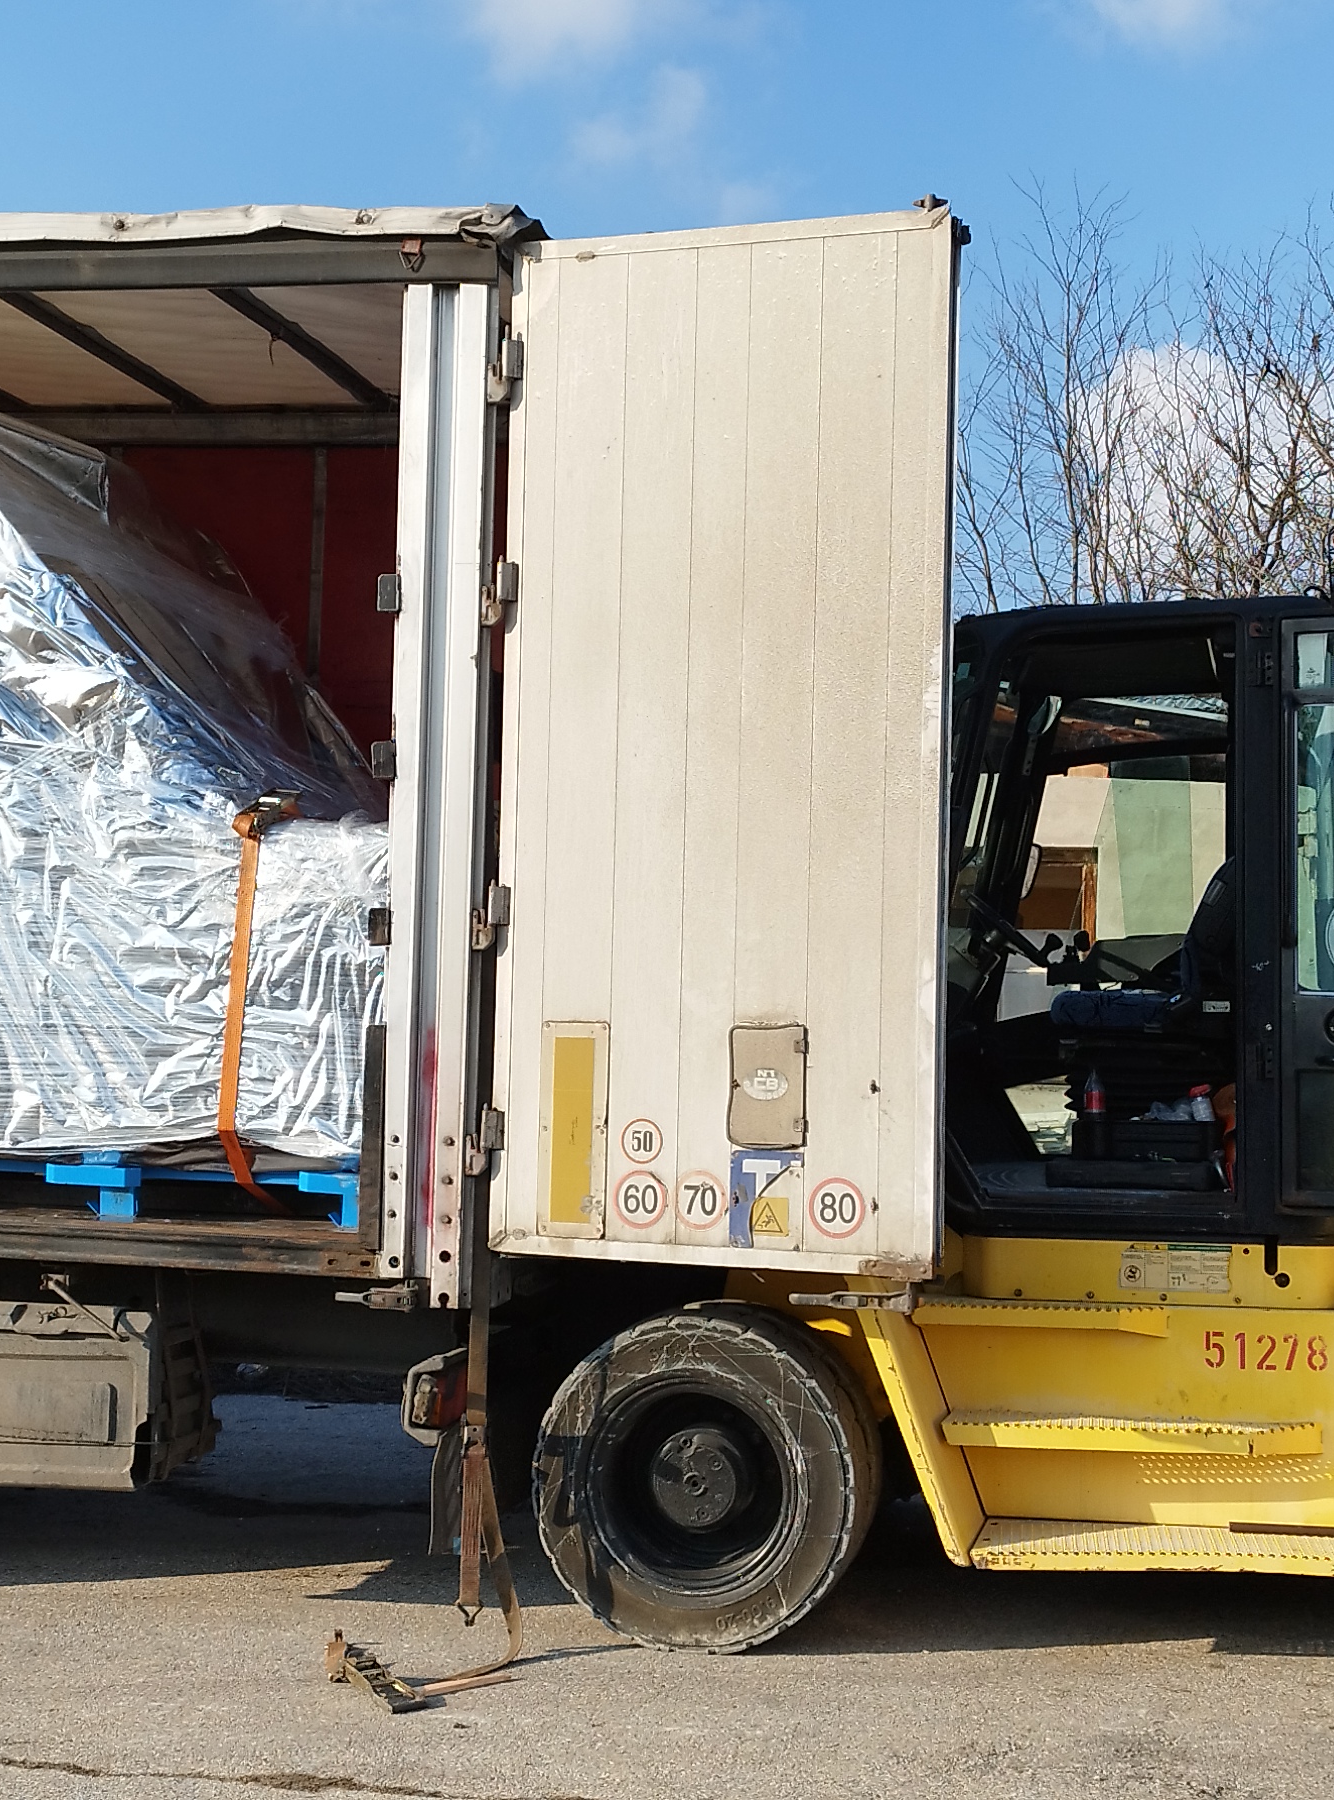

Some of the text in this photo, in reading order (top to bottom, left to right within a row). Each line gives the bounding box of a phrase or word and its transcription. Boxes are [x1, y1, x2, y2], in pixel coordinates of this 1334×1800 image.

[631, 1130, 653, 1153] 50
[623, 1184, 658, 1215] 60
[683, 1184, 717, 1216] 70
[819, 1192, 857, 1224] 80
[1205, 1330, 1328, 1371] 51278
